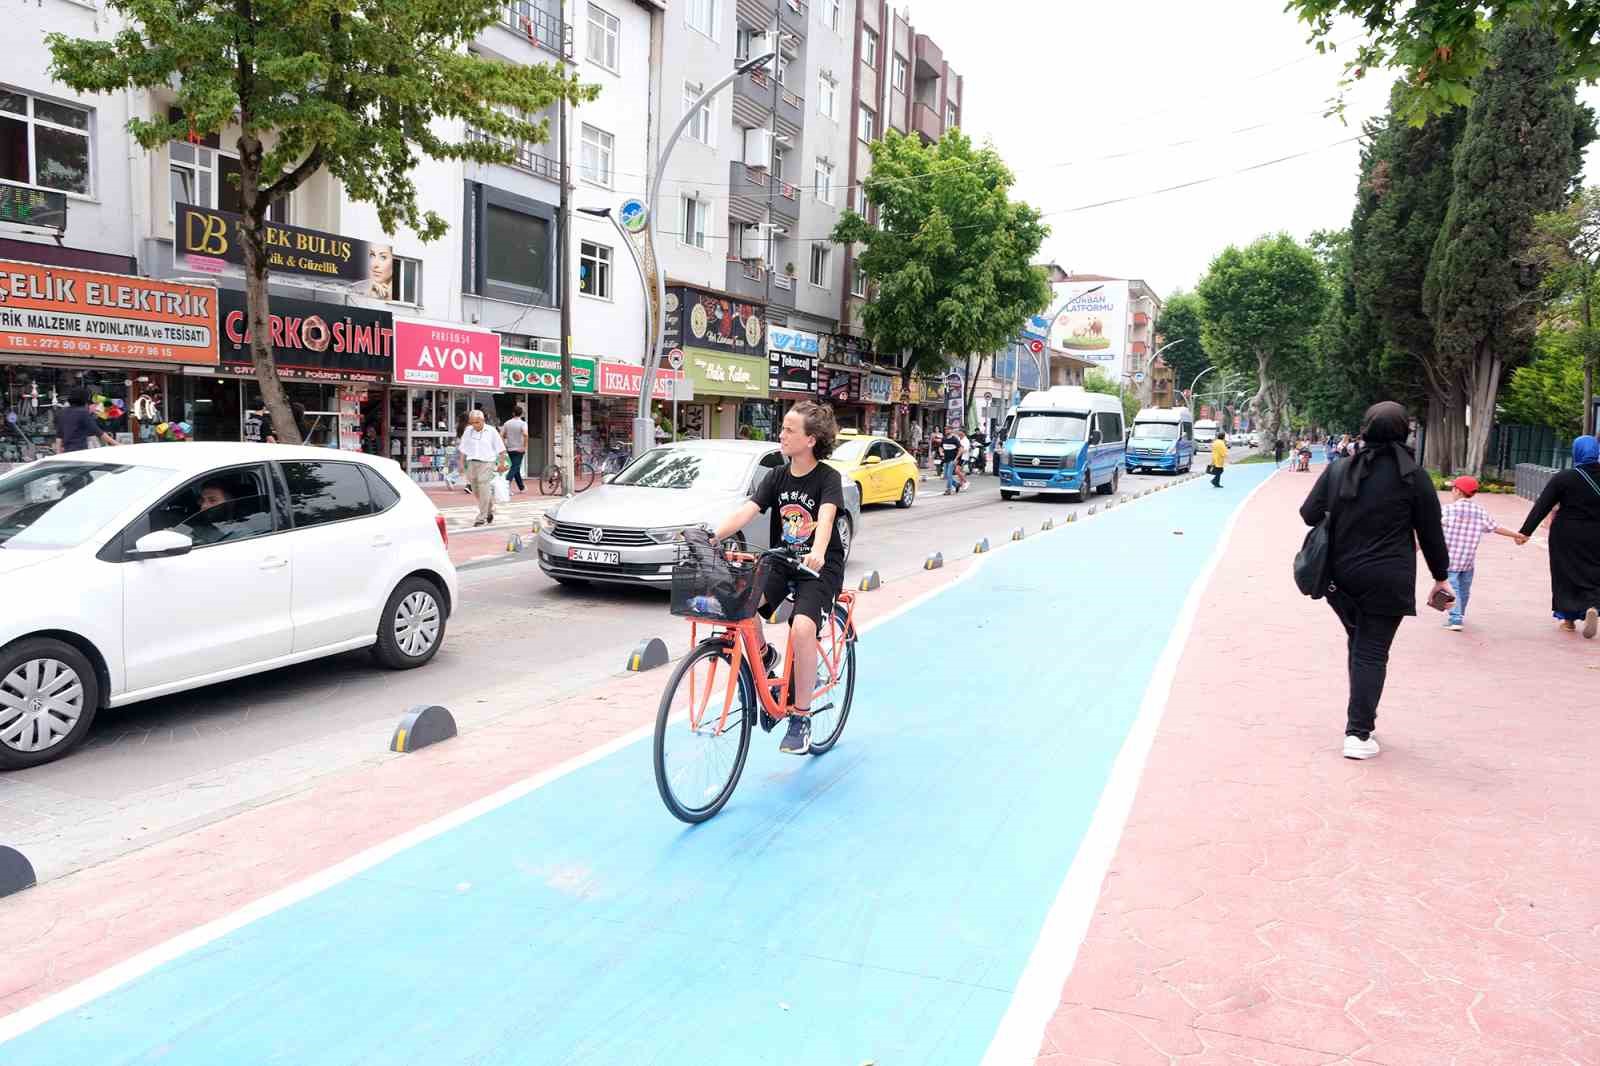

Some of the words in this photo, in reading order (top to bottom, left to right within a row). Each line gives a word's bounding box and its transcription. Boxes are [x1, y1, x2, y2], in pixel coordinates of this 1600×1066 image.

[296, 232, 351, 262] BULUŞ
[298, 257, 339, 274] Güzellik
[86, 281, 209, 318] ELEKTRİK
[0, 309, 22, 327] RİK
[27, 315, 81, 331] MALZEME
[86, 320, 150, 338] AYDINLATMA
[151, 328, 162, 338] ve
[164, 326, 205, 342] TESİSATI
[332, 315, 393, 356] SİMİT
[416, 345, 483, 373] AVON
[573, 550, 583, 560] 54
[587, 552, 599, 561] AV
[603, 552, 618, 563] 712
